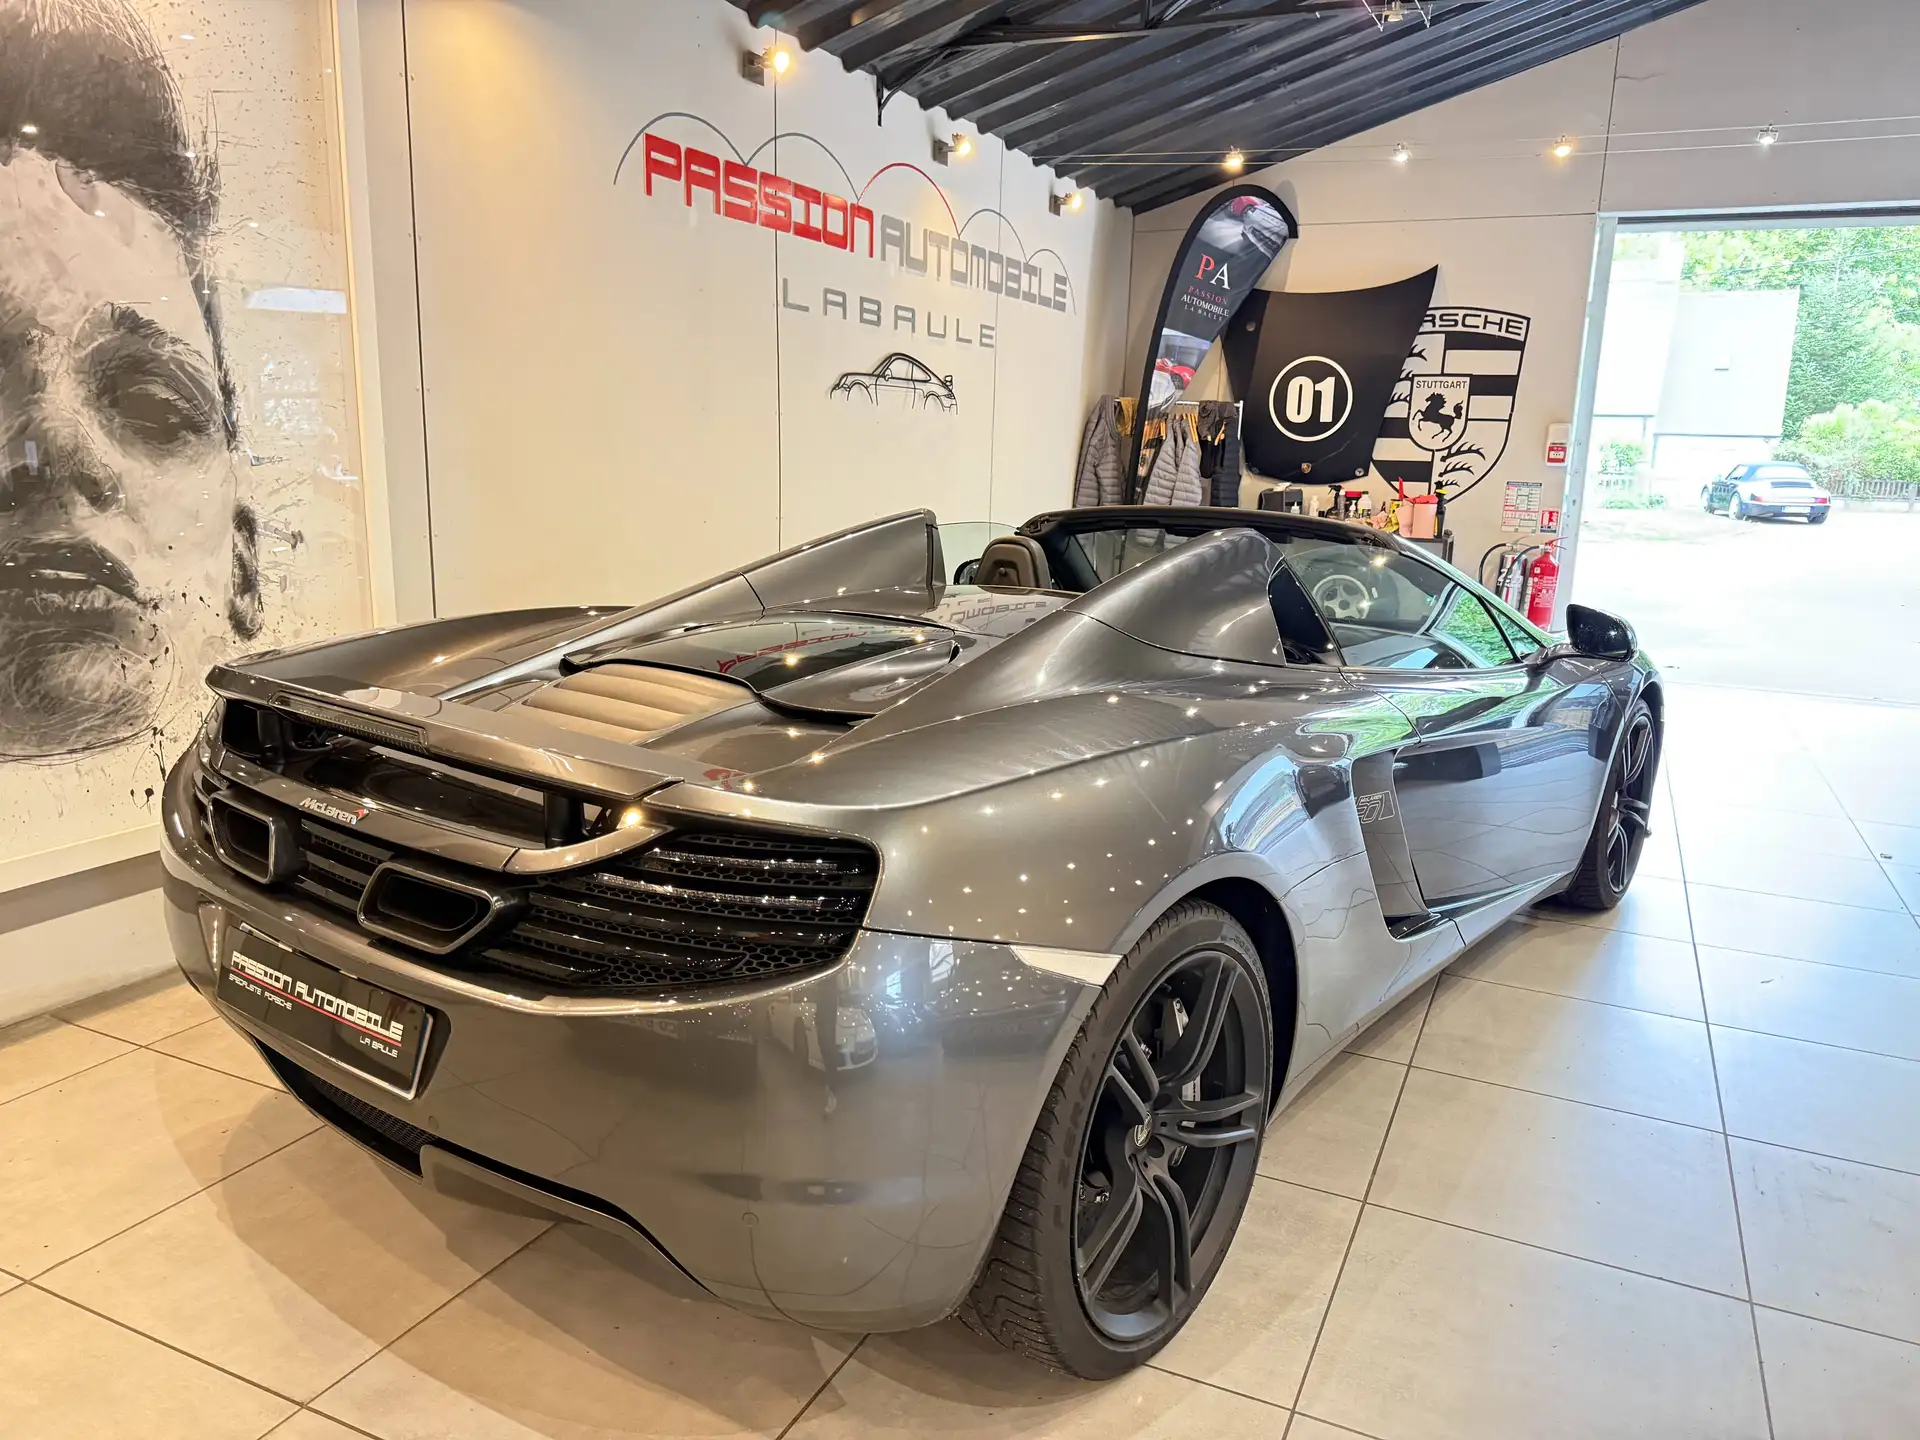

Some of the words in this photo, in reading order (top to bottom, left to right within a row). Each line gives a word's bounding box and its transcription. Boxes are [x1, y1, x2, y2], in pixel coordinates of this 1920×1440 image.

[643, 132, 874, 258] PASSION
[881, 213, 1068, 312] AUTOMOBILE
[1181, 294, 1230, 317] AUTOMOBILE
[1187, 286, 1229, 305] PASSION
[1423, 313, 1524, 336] RSCHE
[1415, 380, 1467, 389] STUTTGART
[1286, 375, 1335, 423] 01
[299, 797, 357, 825] McLaren
[231, 950, 293, 993] PASSION
[294, 981, 404, 1041] AUTOMOBILE
[264, 991, 293, 1011] PORSCHE
[359, 1035, 371, 1047] LA
[371, 1041, 399, 1058] BAULE
